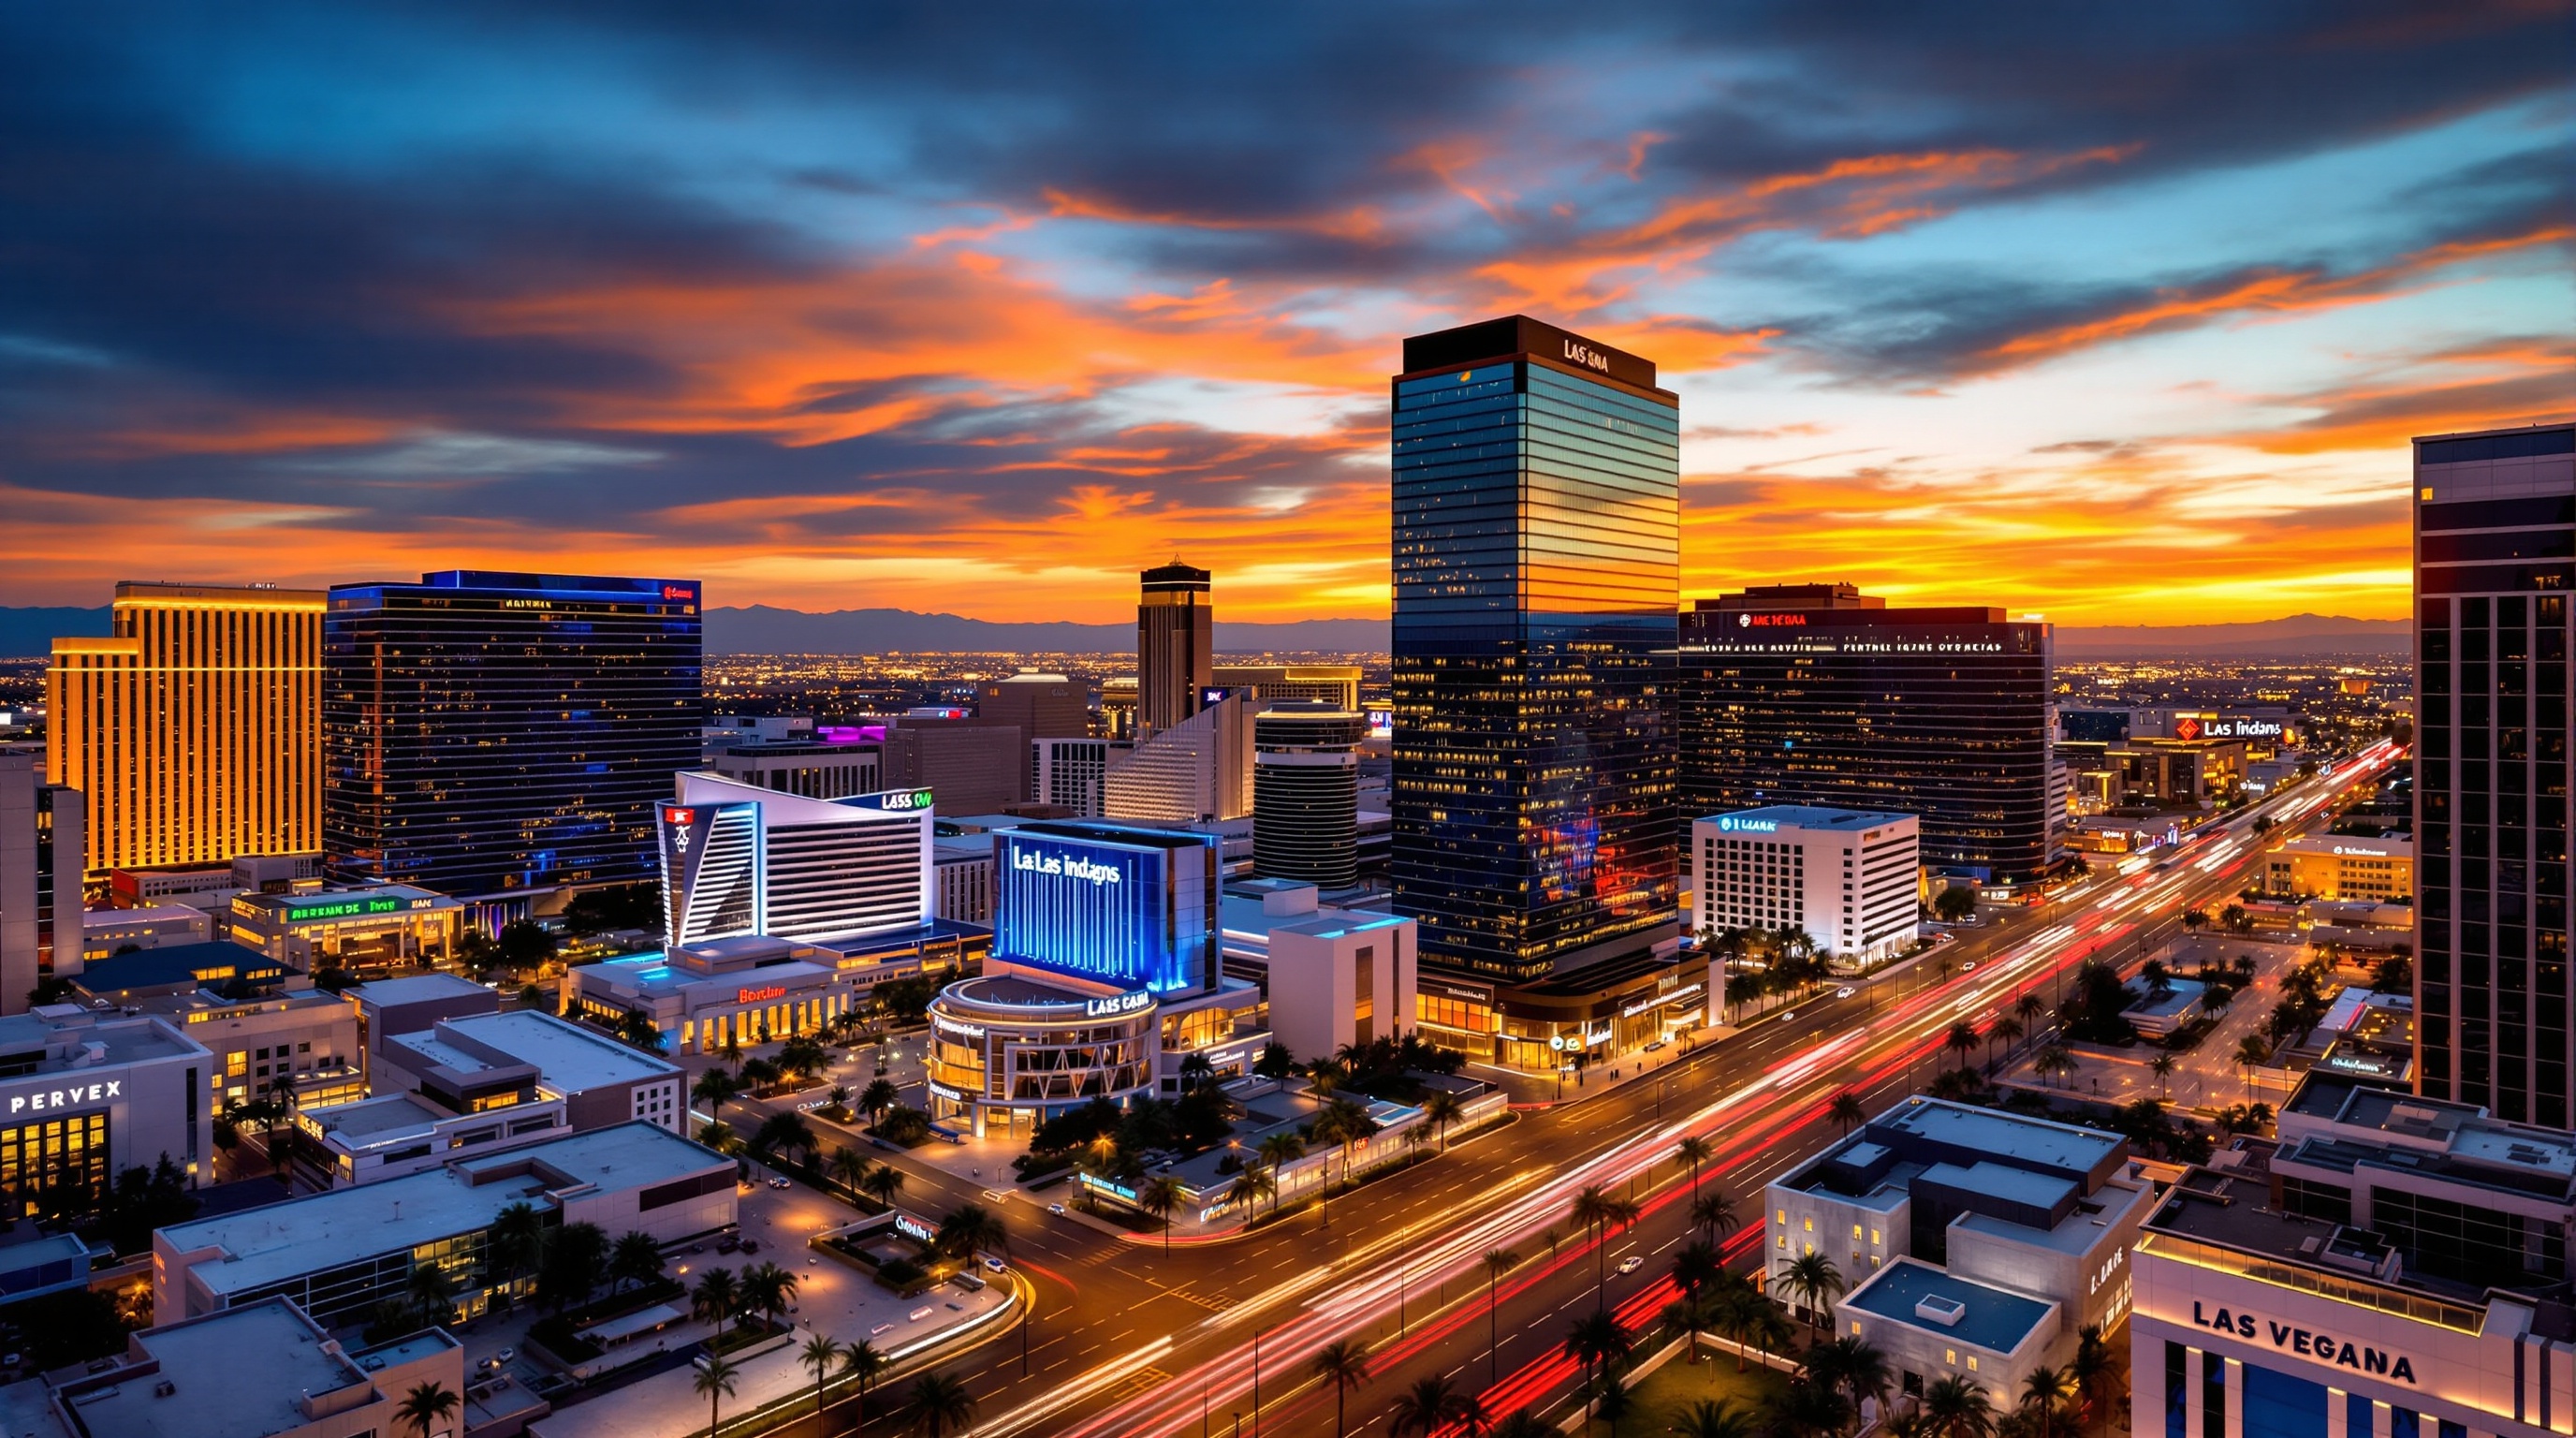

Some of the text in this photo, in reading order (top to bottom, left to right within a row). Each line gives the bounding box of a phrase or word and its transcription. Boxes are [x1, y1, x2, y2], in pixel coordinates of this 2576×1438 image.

[1564, 339, 1588, 364] LAS
[2203, 720, 2232, 737] LAS
[10, 1080, 121, 1114] PERVEX
[2193, 1300, 2417, 1385] LAS VEGANA
